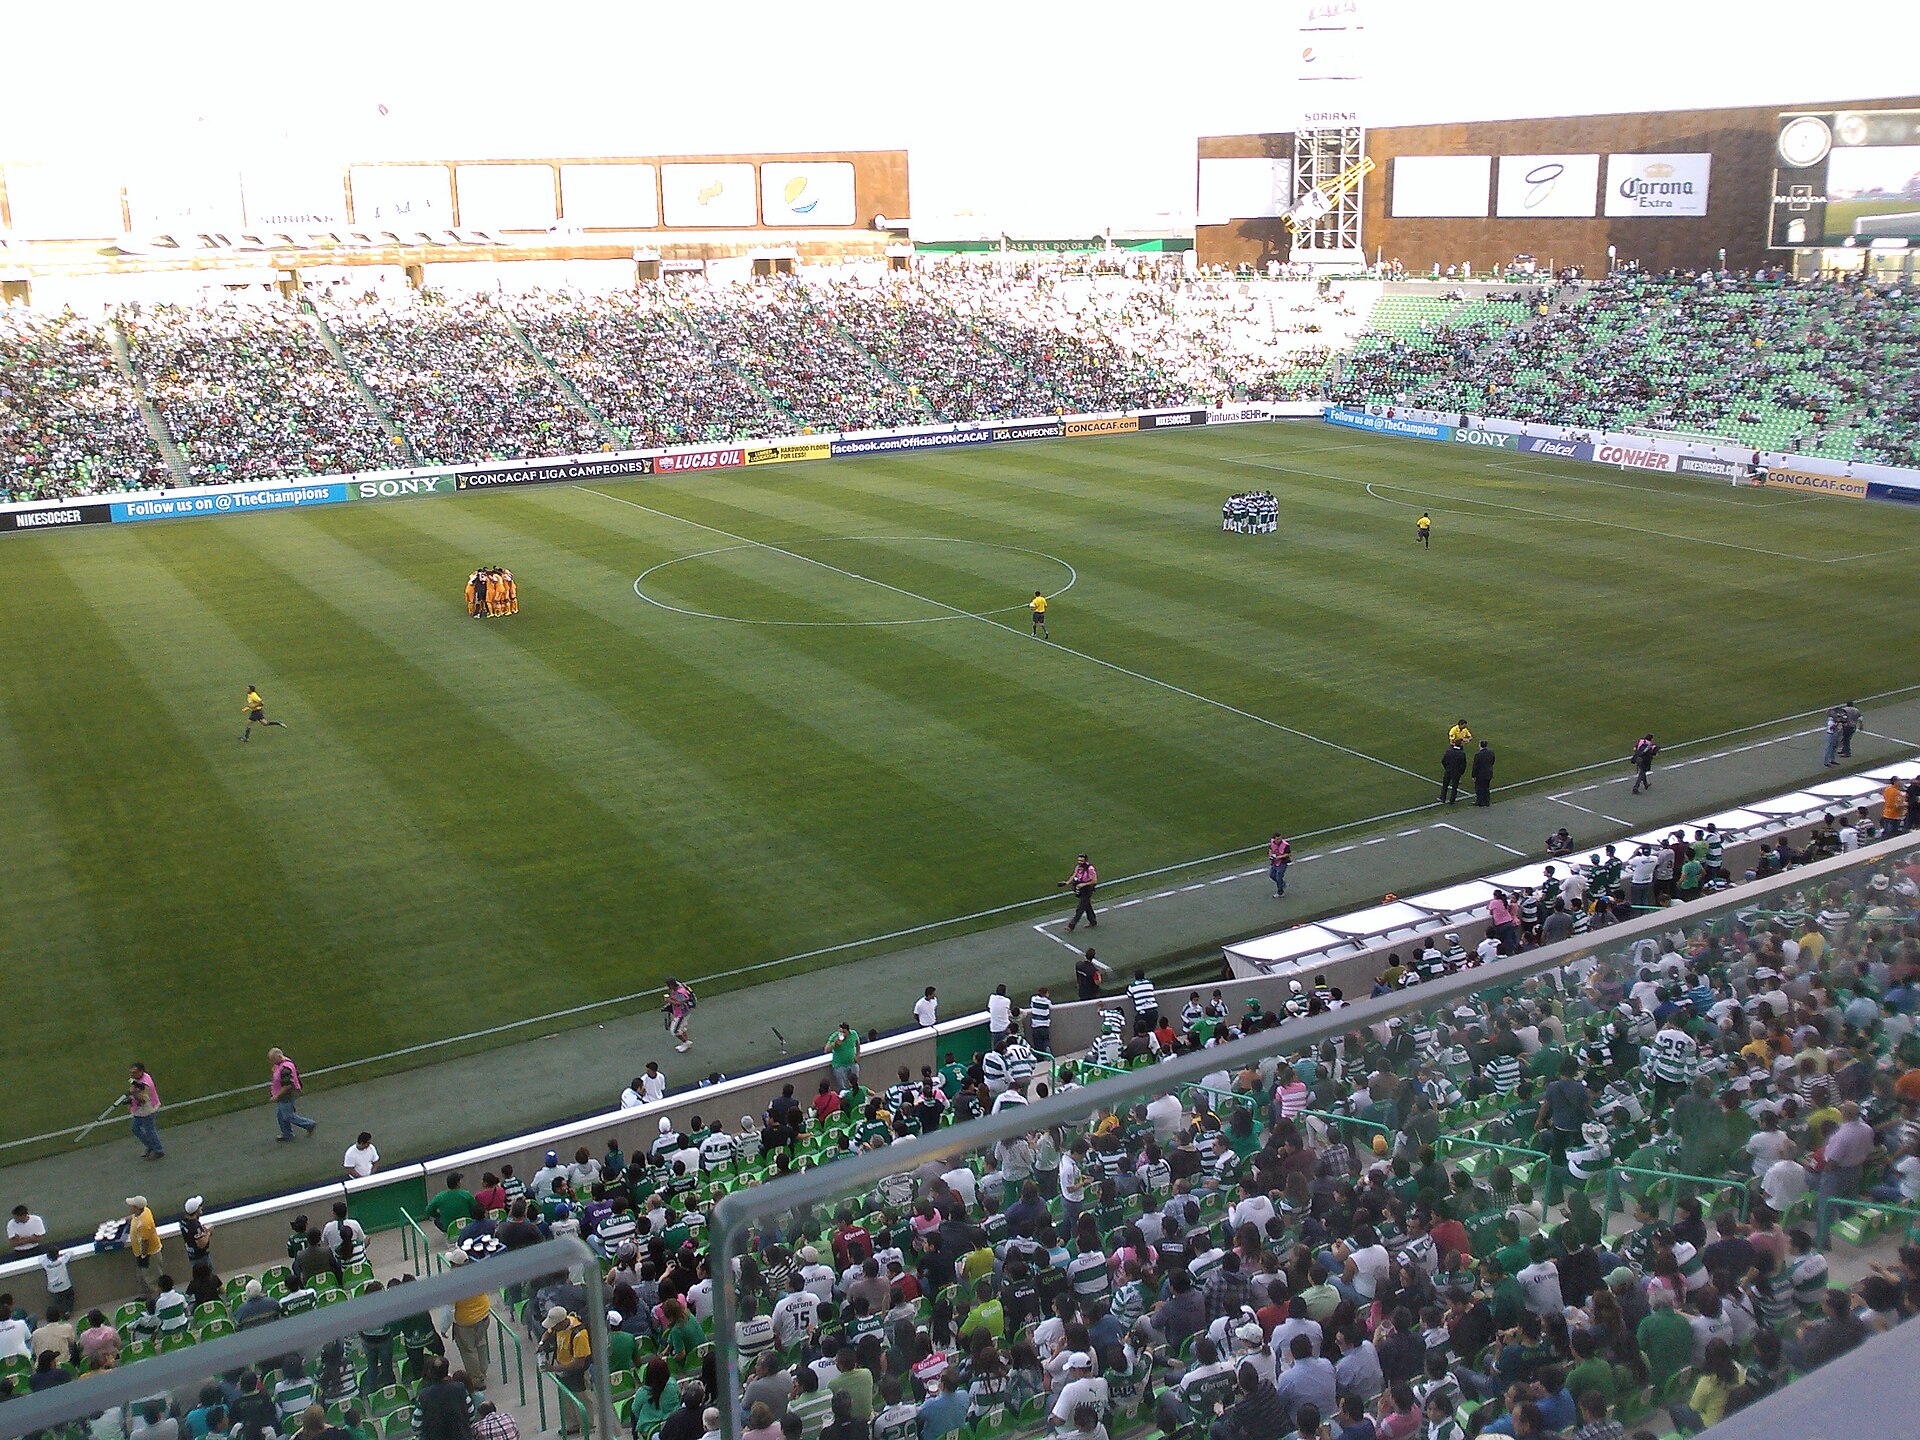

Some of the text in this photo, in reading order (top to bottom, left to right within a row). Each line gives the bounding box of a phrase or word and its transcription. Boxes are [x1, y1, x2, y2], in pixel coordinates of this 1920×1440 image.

[1620, 177, 1694, 200] Corona
[1640, 196, 1673, 208] Extra
[1053, 242, 1084, 250] DOLOR
[1206, 409, 1262, 424] Pinturas BEHR
[1330, 410, 1438, 436] Follow us on @ TheChampions
[993, 427, 1058, 440] LIGA CAMPEONES
[1067, 420, 1137, 434] CONCACAF.com
[831, 431, 989, 454] facebook.com/OfficialCONCACAF
[1455, 428, 1509, 448] SONY
[1542, 441, 1575, 457] telcel
[1599, 446, 1669, 470] GONHER
[675, 453, 717, 470] LUCAS
[719, 449, 741, 466] OIL
[469, 461, 642, 487] CONCACAF LIGA CAMPEONES
[1768, 472, 1864, 494] CONCACAF.com
[359, 477, 440, 499] SONY
[127, 486, 329, 517] Follow us on @ TheChampions
[16, 509, 81, 528] NIKESOCCER
[786, 1301, 812, 1312] Corona
[793, 1311, 810, 1330] 15
